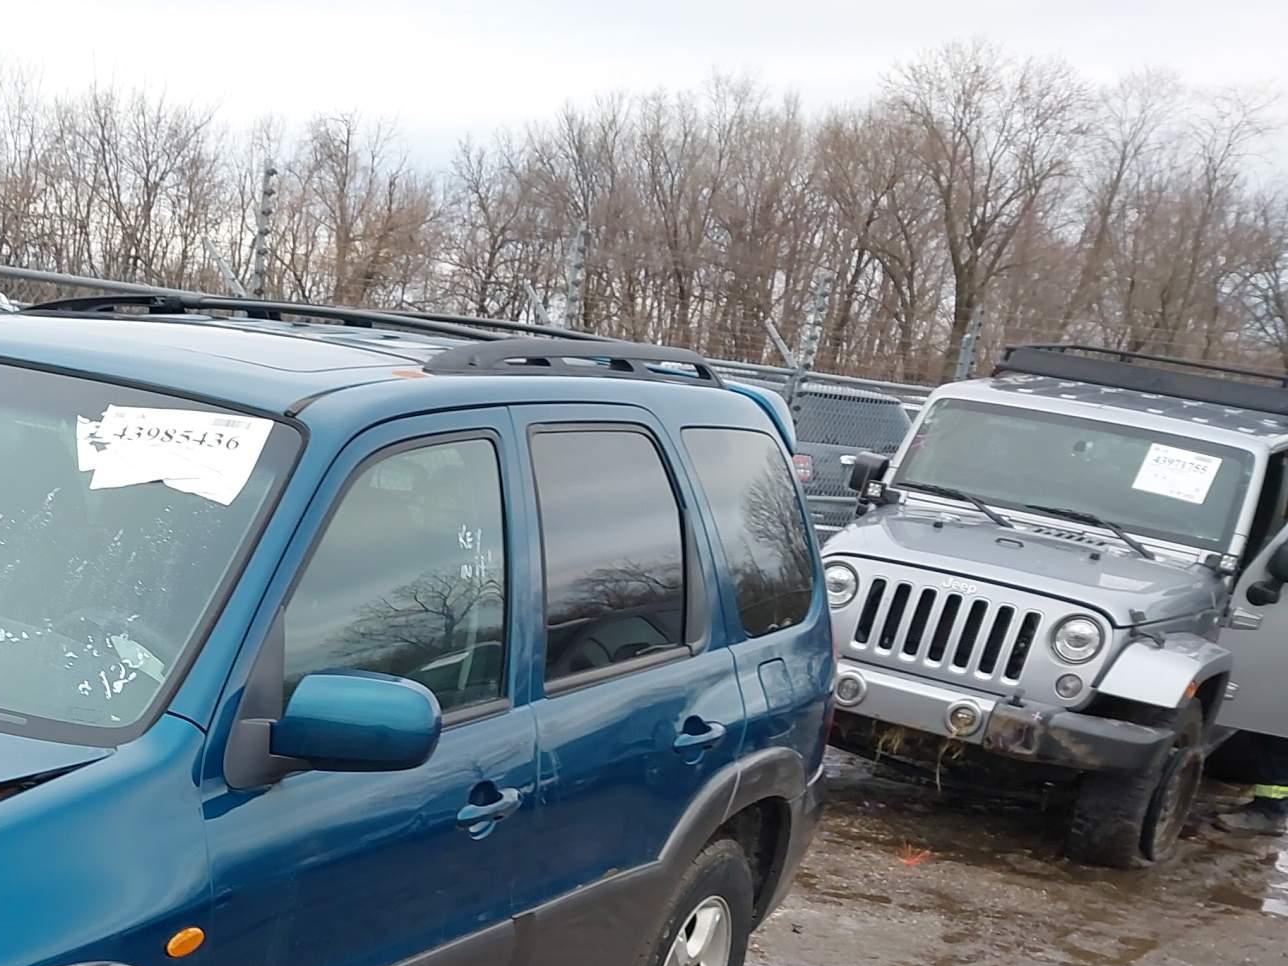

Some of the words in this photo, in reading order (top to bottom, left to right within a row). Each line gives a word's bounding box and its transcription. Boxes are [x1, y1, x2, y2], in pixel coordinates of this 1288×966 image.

[113, 425, 241, 450] 43985436
[1152, 455, 1209, 474] 43971755
[942, 577, 977, 595] Jeep
